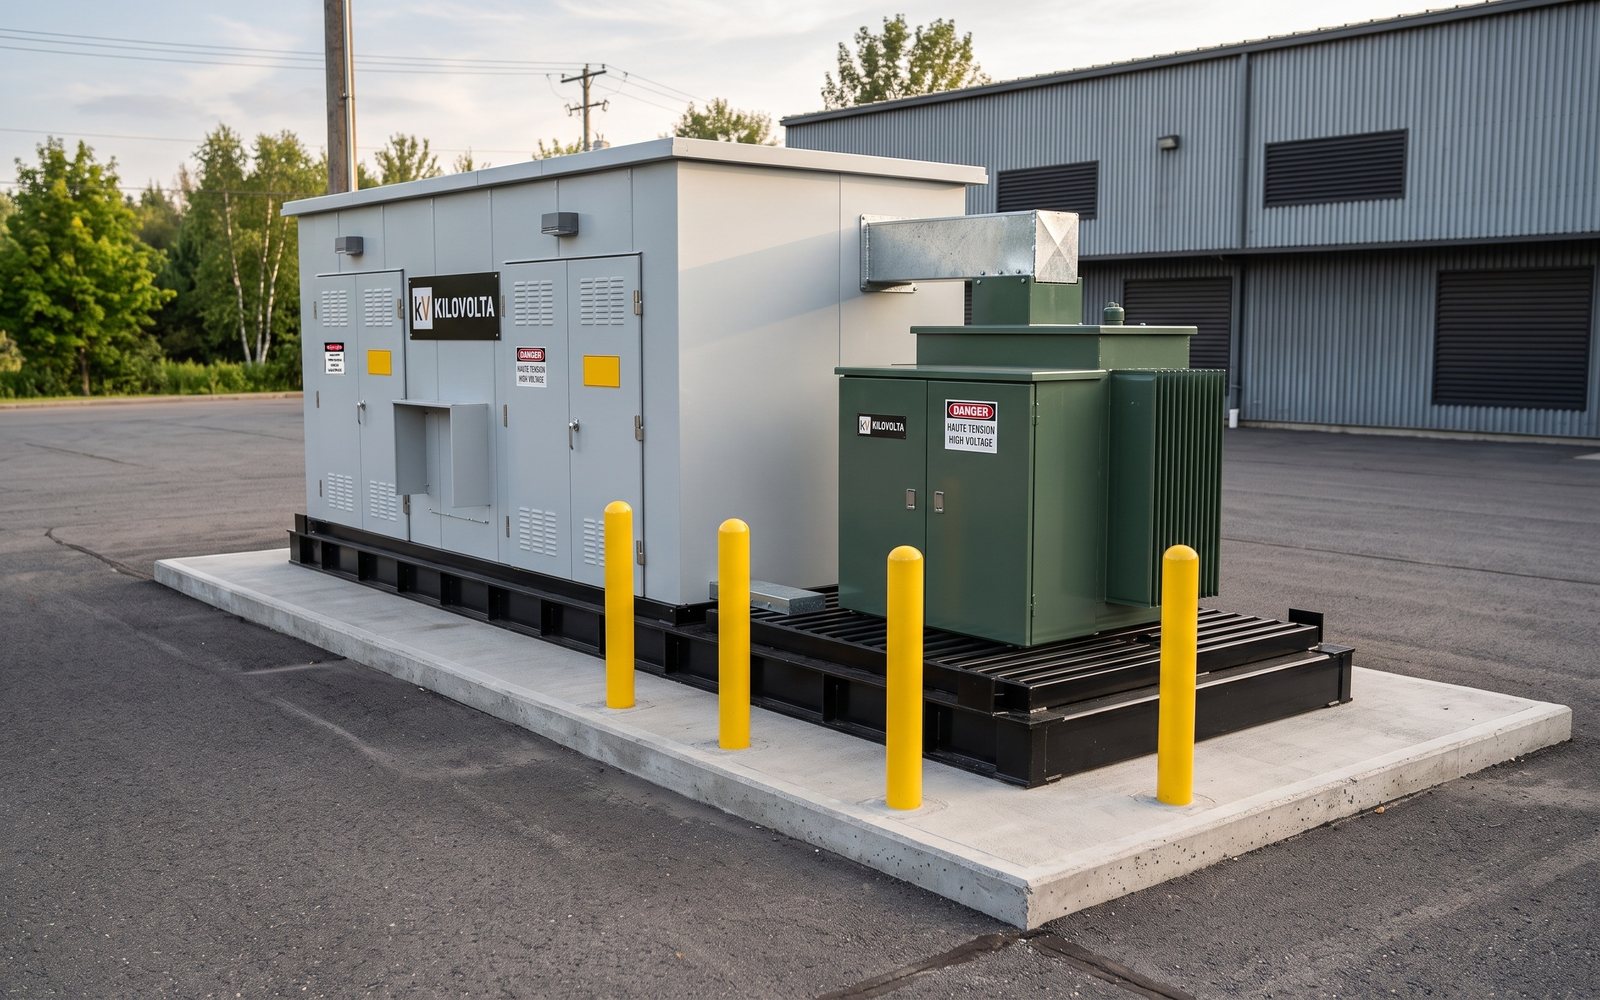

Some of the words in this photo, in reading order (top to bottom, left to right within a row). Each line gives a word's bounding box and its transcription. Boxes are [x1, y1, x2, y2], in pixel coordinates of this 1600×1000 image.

[434, 296, 495, 318] KILOVOLTA
[953, 406, 988, 417] DANGER
[872, 421, 904, 431] KILOVOLTA
[947, 423, 966, 432] HAUTE
[968, 424, 995, 434] TENSION
[948, 435, 964, 444] HIGH
[966, 437, 992, 447] VOLTAGE
